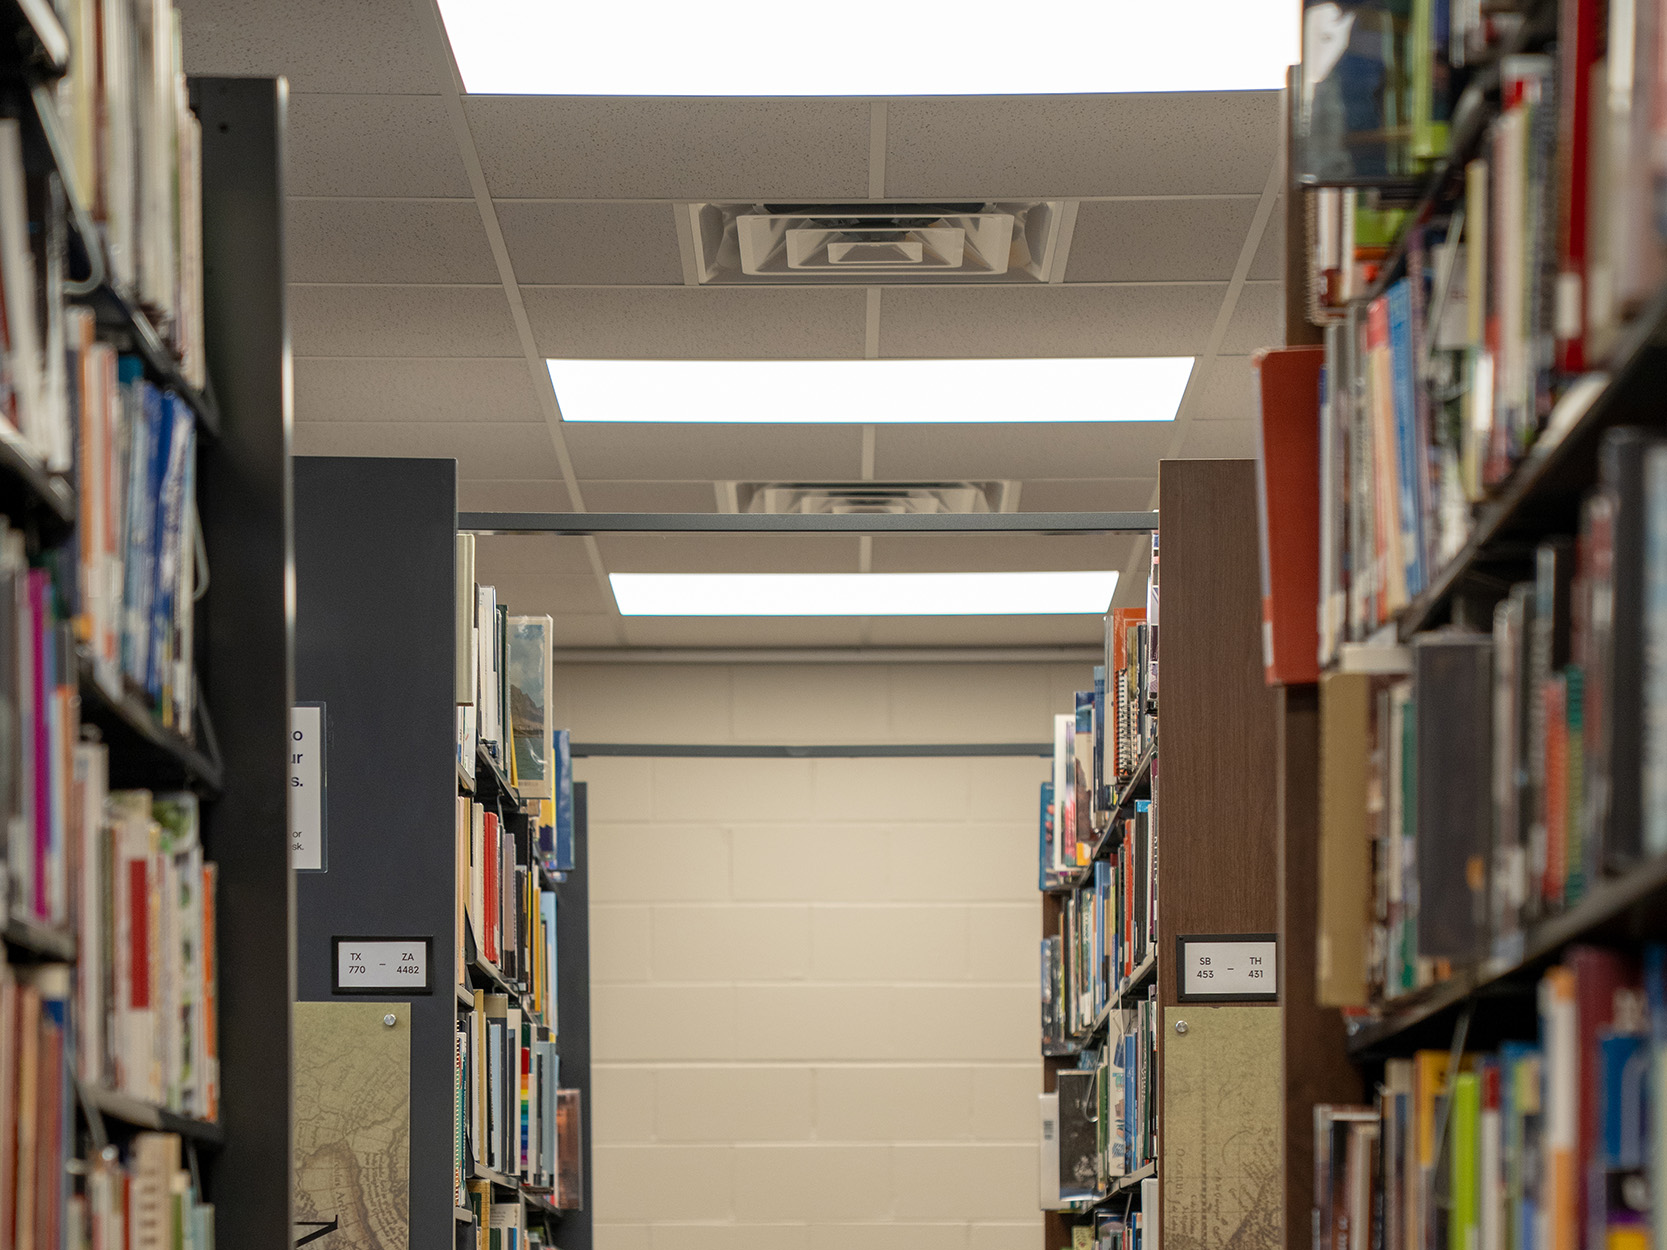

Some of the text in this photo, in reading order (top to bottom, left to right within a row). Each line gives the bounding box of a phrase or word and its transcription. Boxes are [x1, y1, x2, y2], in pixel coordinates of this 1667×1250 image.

[350, 952, 415, 961] TX ZA
[1199, 956, 1262, 966] SB TH
[348, 965, 420, 974] 770 4482
[1196, 969, 1264, 979] 453 431
